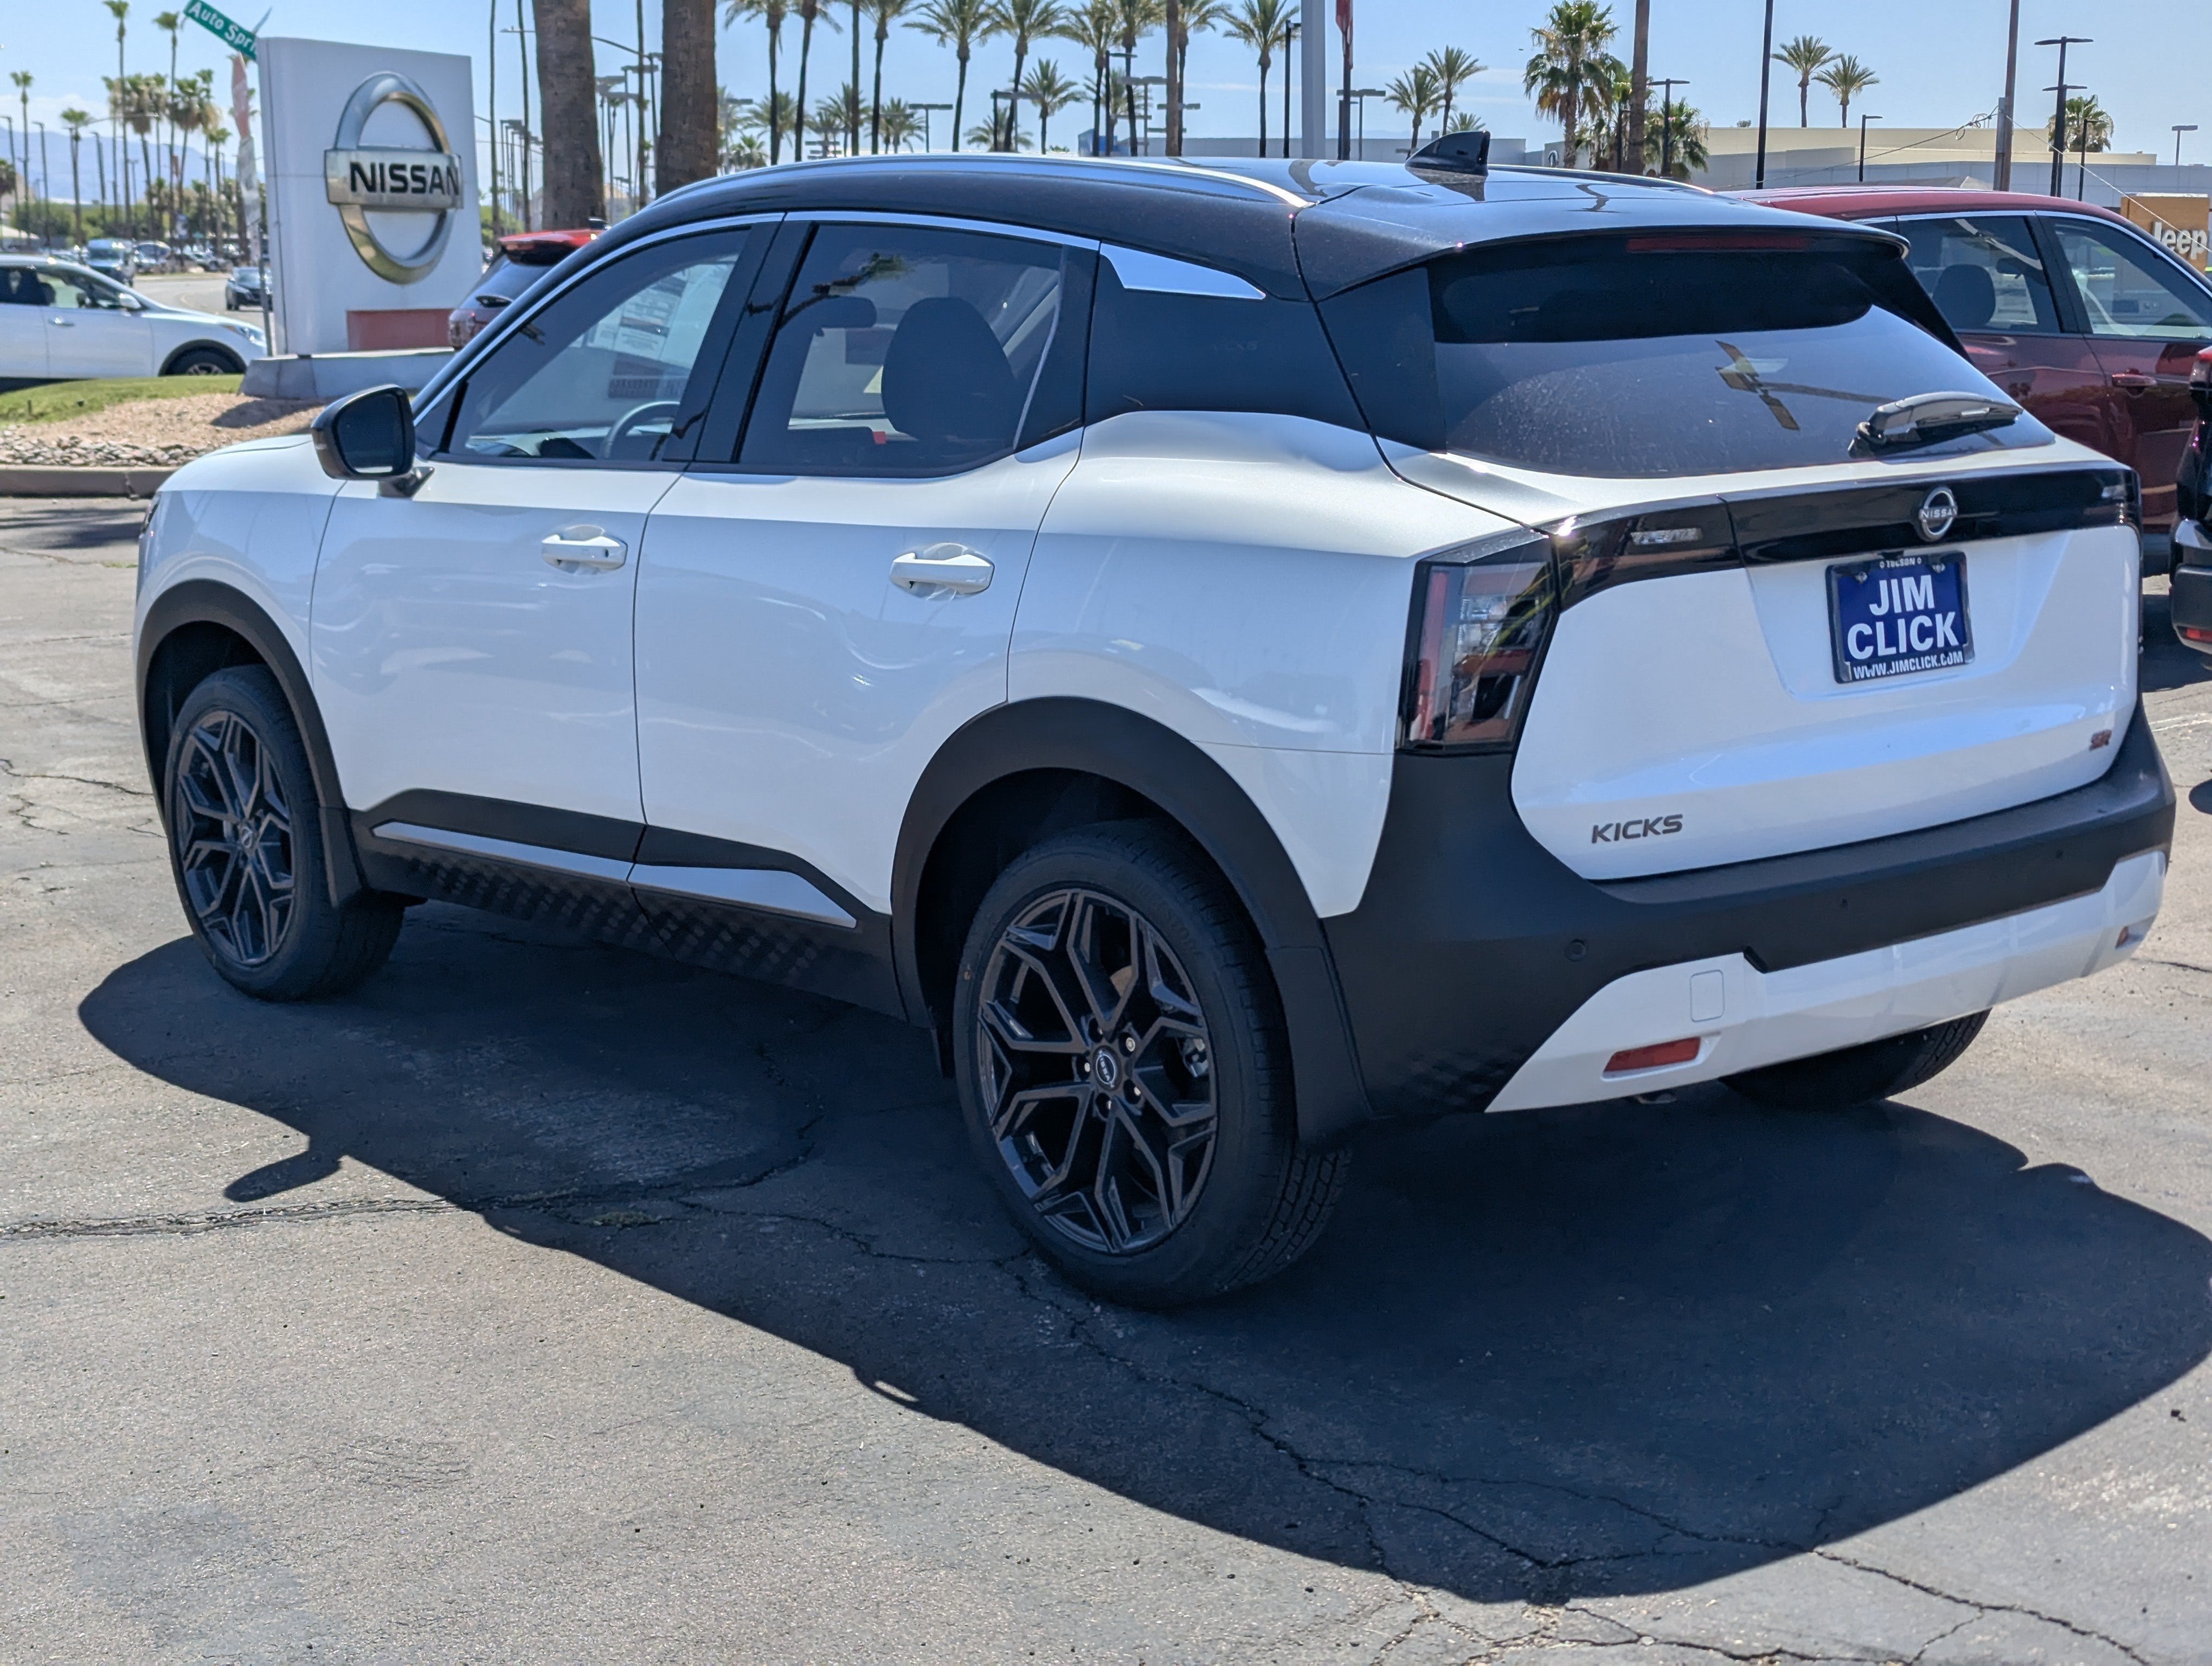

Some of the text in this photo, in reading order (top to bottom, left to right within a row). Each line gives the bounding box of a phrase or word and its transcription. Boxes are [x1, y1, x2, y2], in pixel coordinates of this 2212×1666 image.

[188, 1, 224, 29] Auto
[350, 162, 459, 195] NISSAN
[2154, 221, 2208, 260] Jeep
[1921, 507, 1957, 519] NISSAN
[1869, 574, 1934, 616] JIM
[1847, 612, 1959, 660] CLICK
[1853, 650, 1964, 679] WWW.JIMCLICK.COM
[1591, 813, 1683, 844] KICKS
